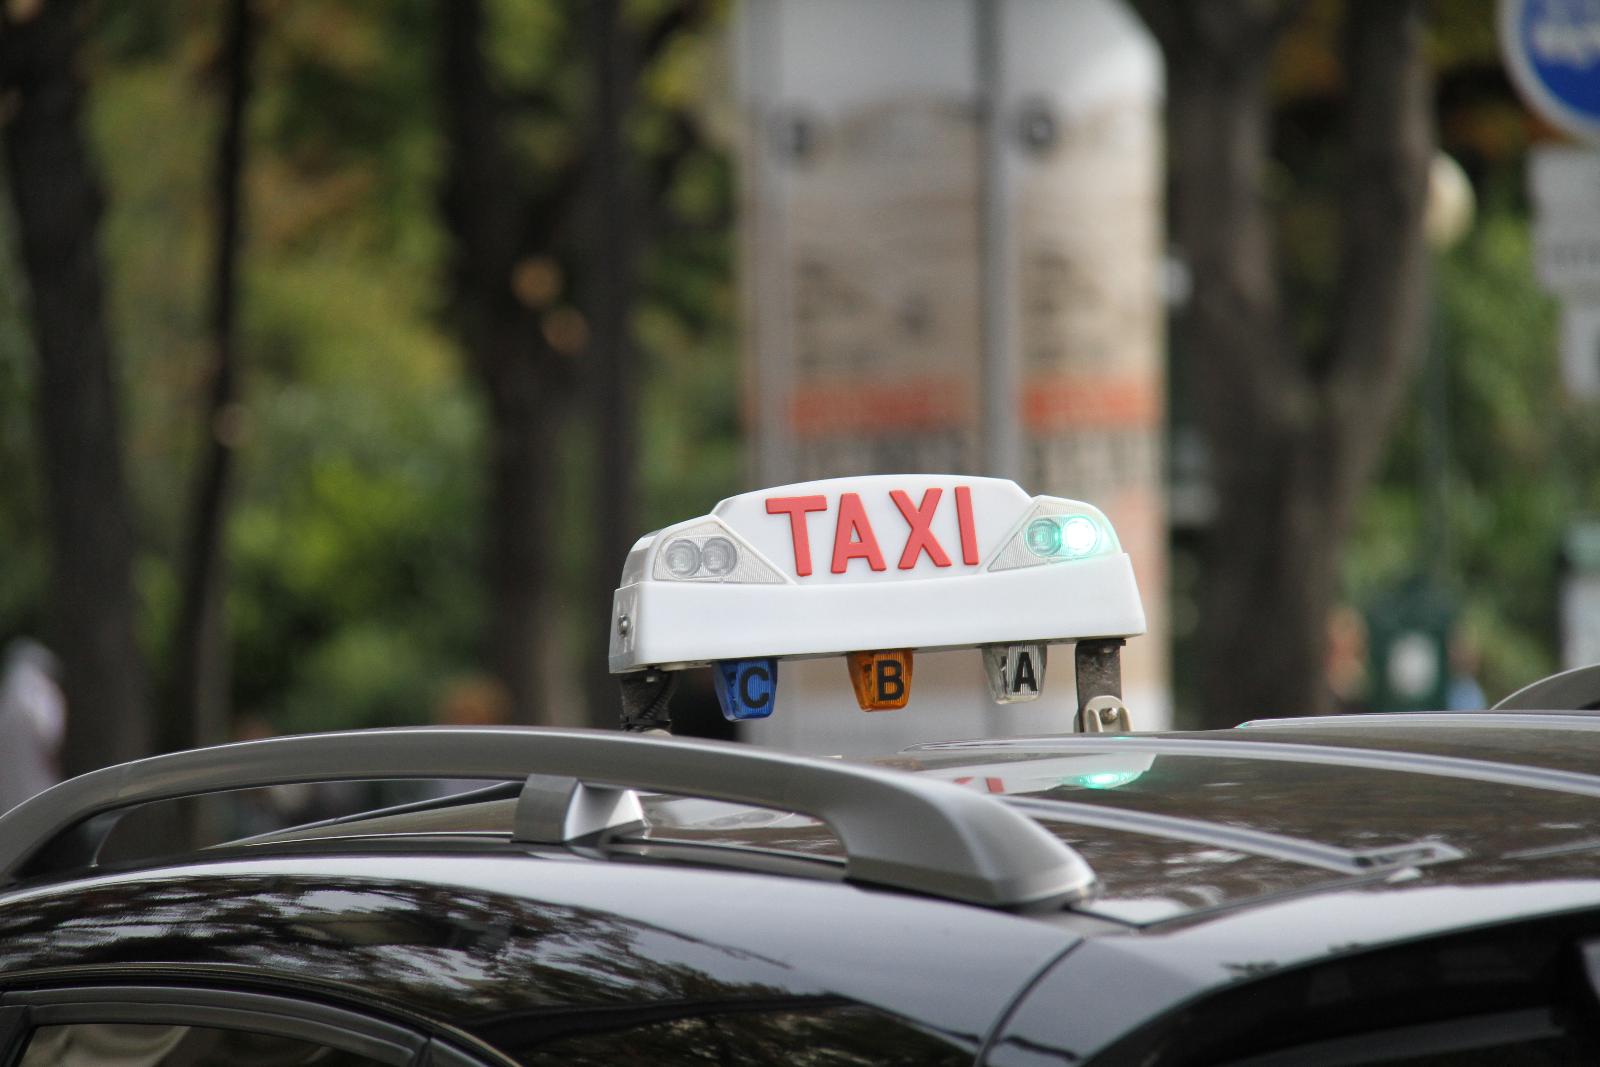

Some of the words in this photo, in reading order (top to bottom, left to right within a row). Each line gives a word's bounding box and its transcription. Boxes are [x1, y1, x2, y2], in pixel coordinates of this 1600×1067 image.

[766, 486, 979, 577] TAXI
[739, 667, 769, 709] C
[878, 660, 904, 701] B
[1013, 651, 1039, 693] A
